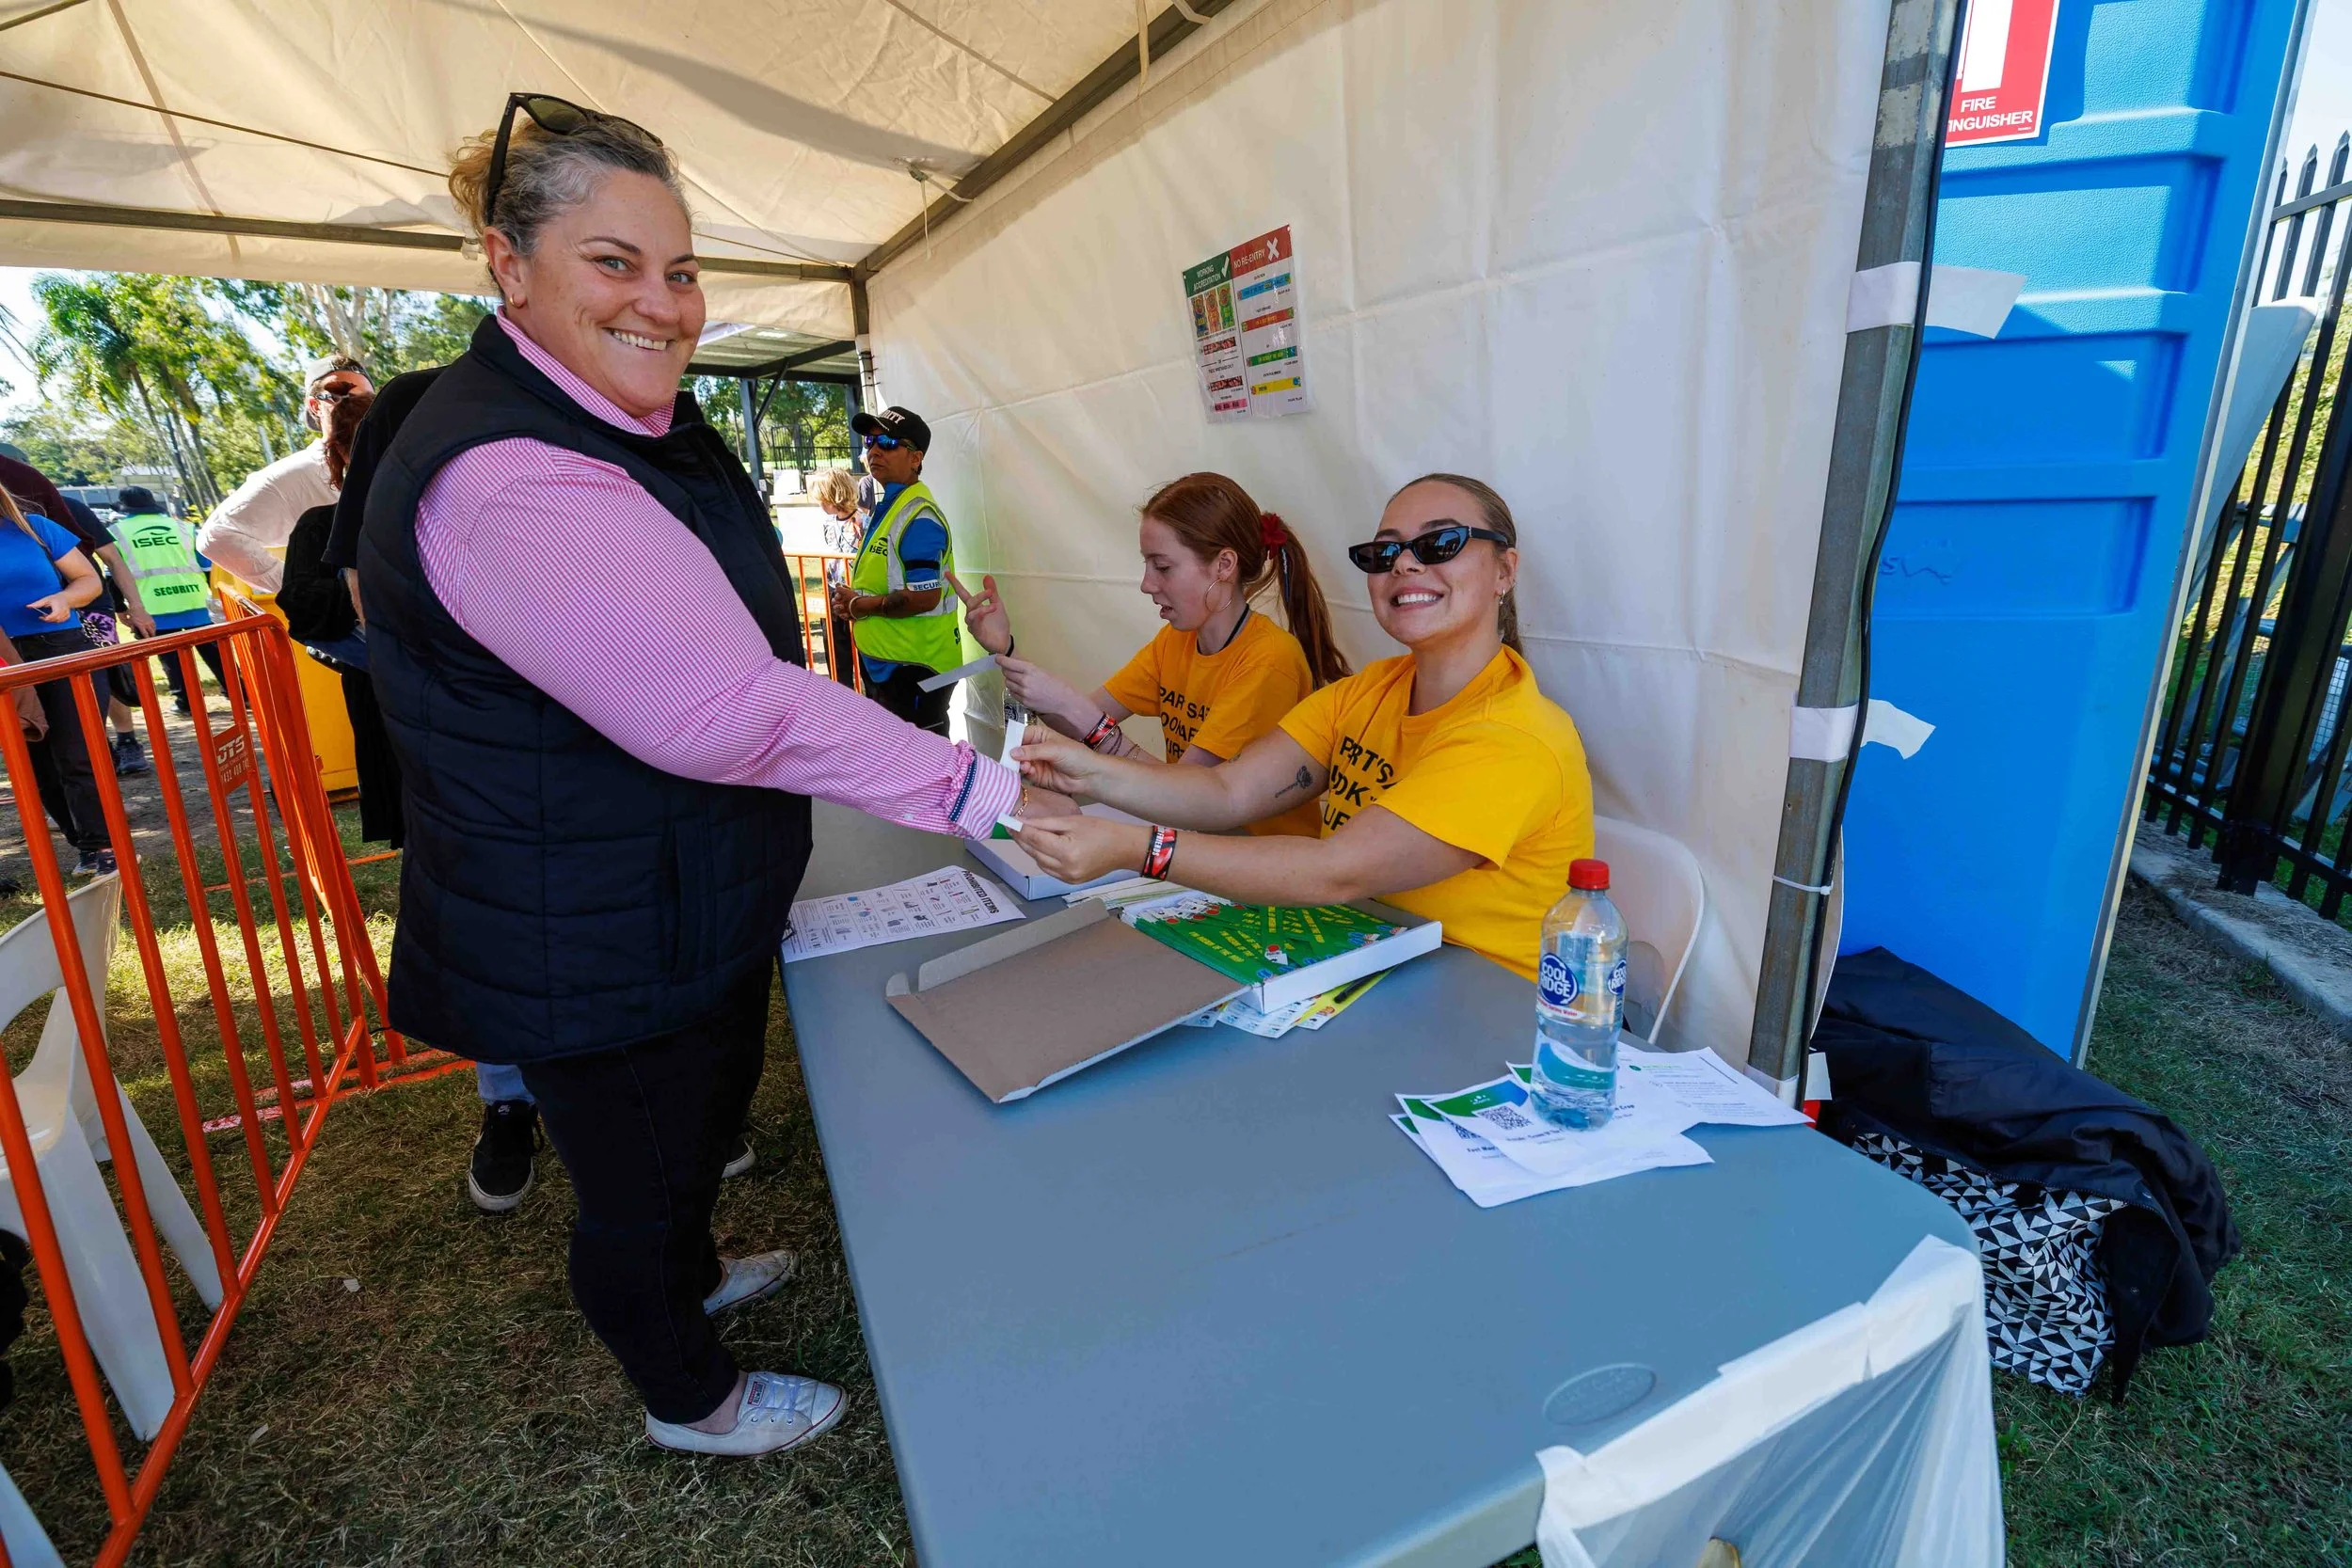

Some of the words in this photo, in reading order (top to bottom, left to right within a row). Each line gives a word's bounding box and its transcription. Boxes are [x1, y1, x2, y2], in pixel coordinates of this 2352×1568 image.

[1961, 96, 1996, 113] FIRE
[1948, 110, 2033, 133] INGUISHER
[1233, 259, 1242, 269] NO
[1242, 248, 1265, 267] RE-ENTRY
[1197, 264, 1215, 278] WORKING
[132, 536, 180, 548] ISEC
[153, 584, 200, 597] SECURITY
[216, 734, 245, 765] JTS
[961, 870, 988, 897] PROHIBITED
[980, 896, 999, 913] ITEMS
[1542, 961, 1570, 984] COOL
[1540, 973, 1571, 997] RIDGE
